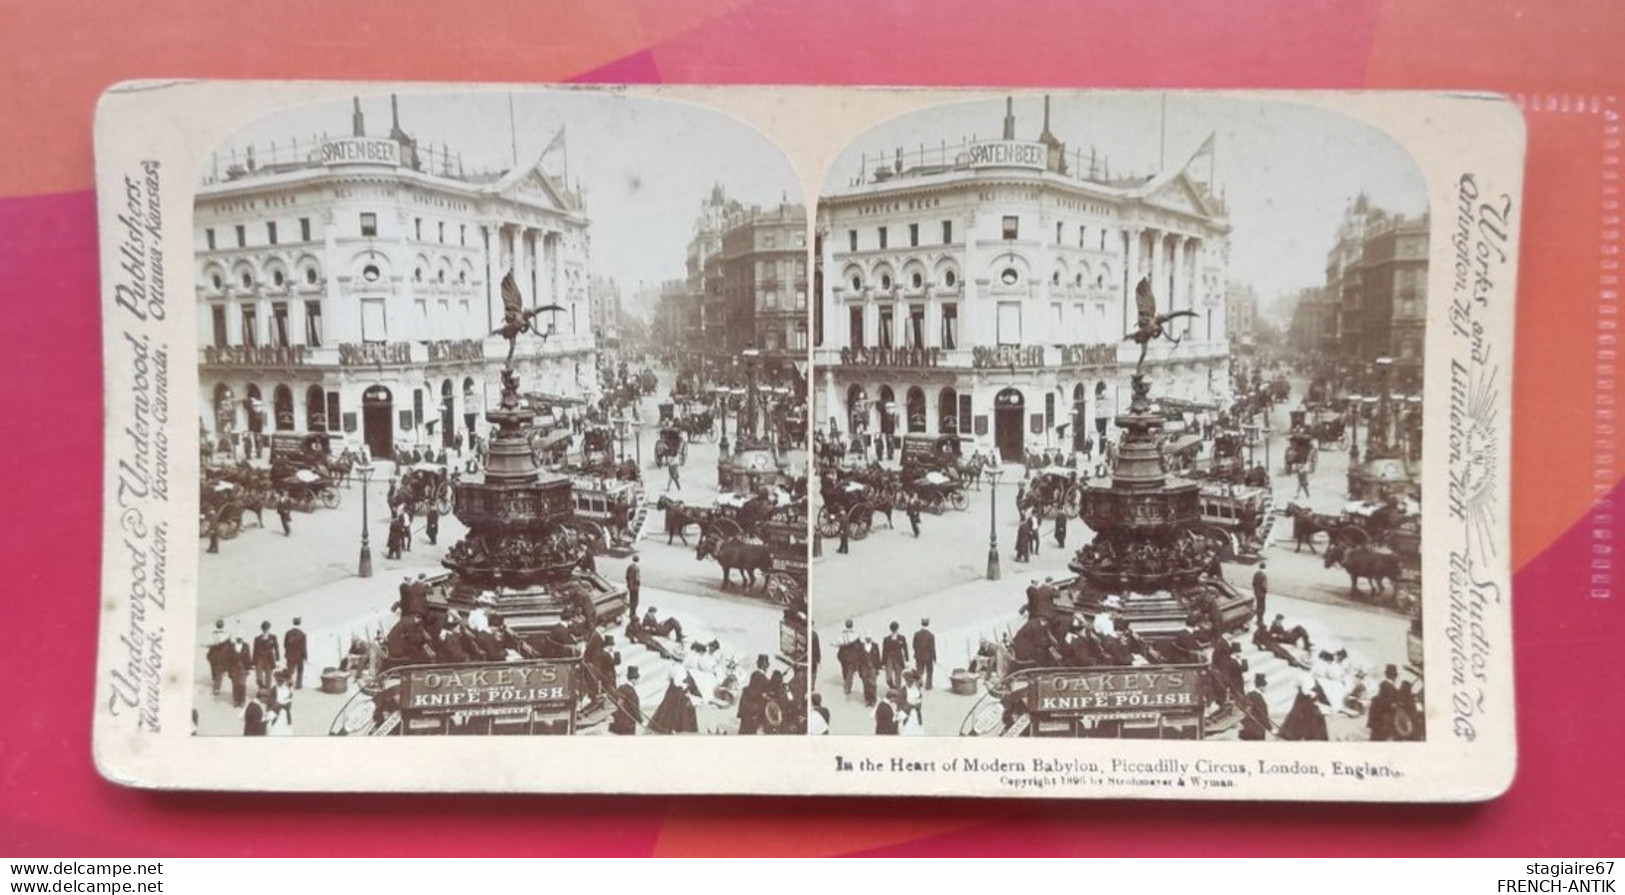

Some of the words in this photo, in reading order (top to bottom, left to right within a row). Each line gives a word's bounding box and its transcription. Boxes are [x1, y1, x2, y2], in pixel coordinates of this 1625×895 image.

[321, 140, 365, 162] SPATEN
[367, 141, 395, 161] BEER
[968, 143, 1013, 165] SPATEN
[1015, 144, 1046, 165] BEER
[1473, 193, 1511, 308] Works
[1471, 321, 1488, 366] and
[840, 346, 940, 367] RESTAURANT
[120, 507, 147, 539] &
[109, 540, 147, 717] Underwood
[1468, 557, 1501, 682] Studios
[423, 667, 558, 689] OAKEY'S
[1052, 672, 1184, 693] OAKEY'S
[413, 689, 481, 706] KNIFE
[488, 686, 565, 702] POLISH
[1041, 693, 1108, 709] KNIFE
[1115, 692, 1192, 707] POLISH
[834, 755, 853, 772] In
[859, 757, 885, 772] the
[890, 757, 936, 773] Heart
[942, 757, 958, 772] of
[963, 757, 1026, 773] Modern
[1031, 757, 1105, 776] Babylon,
[1111, 758, 1189, 776] Piccadilly
[1194, 759, 1253, 776] Circus,
[1257, 759, 1326, 777] London,
[999, 775, 1056, 788] Copyright
